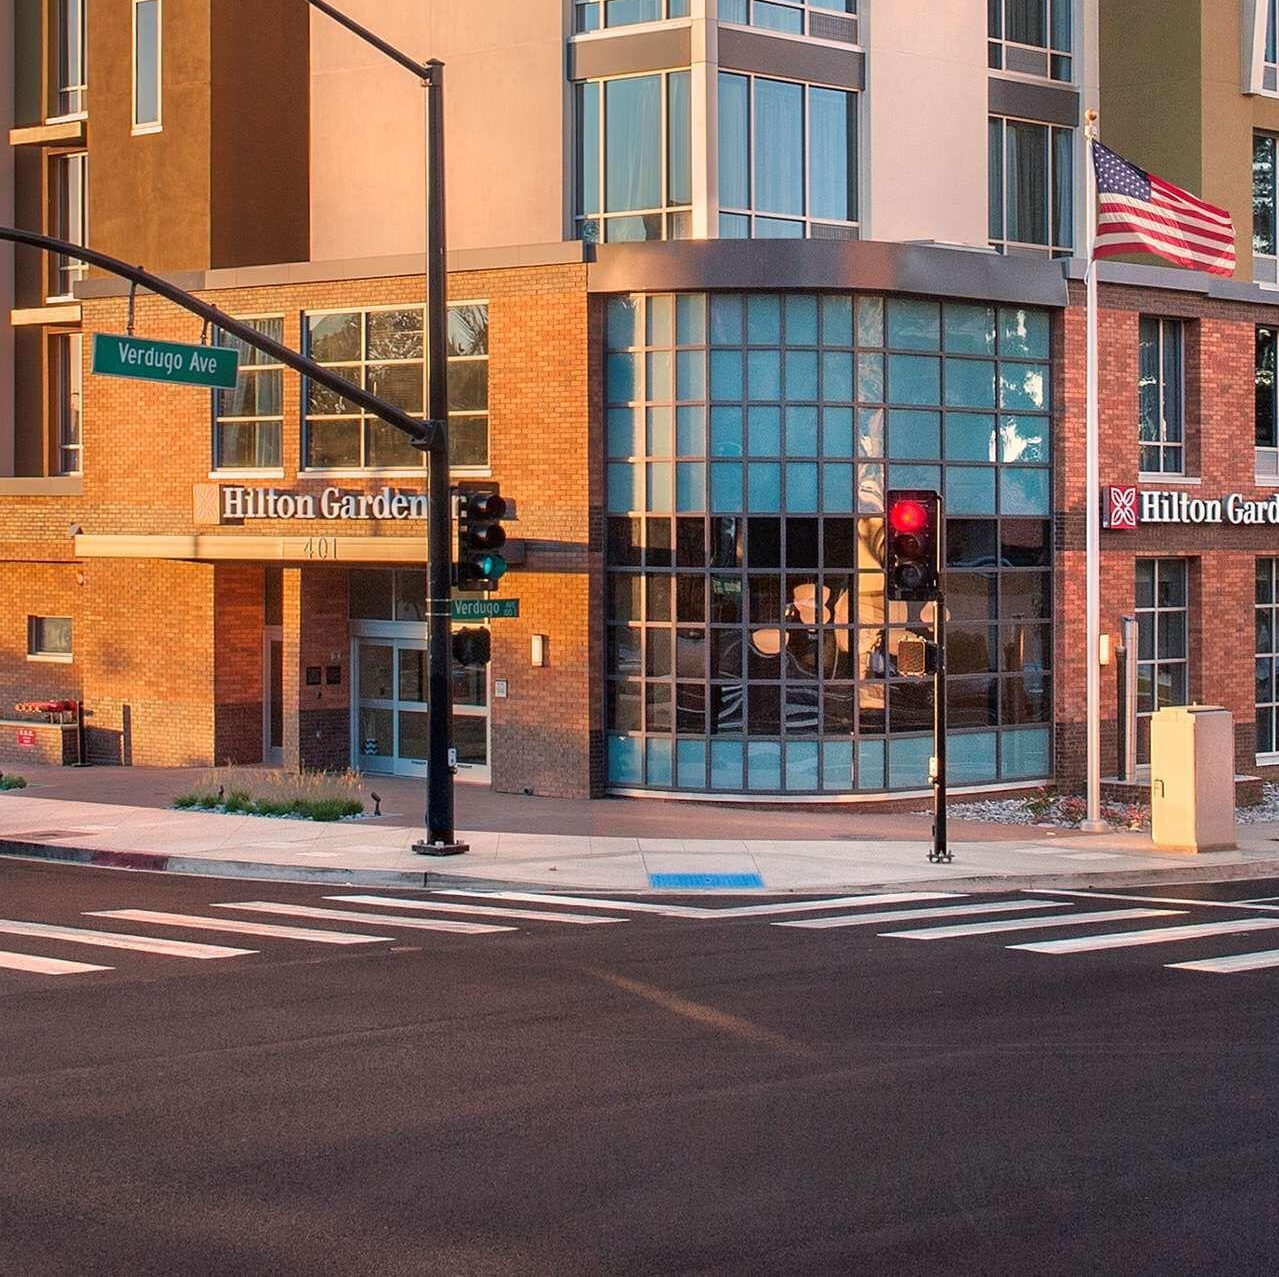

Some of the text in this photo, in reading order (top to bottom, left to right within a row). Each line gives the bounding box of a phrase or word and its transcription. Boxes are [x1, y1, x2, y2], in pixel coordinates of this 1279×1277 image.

[118, 342, 217, 375] Verdugo Ave
[223, 487, 316, 519] Hilton
[320, 487, 429, 519] Garden
[1140, 490, 1223, 523] Hilton
[303, 537, 338, 559] 401
[454, 600, 500, 616] Verdugo
